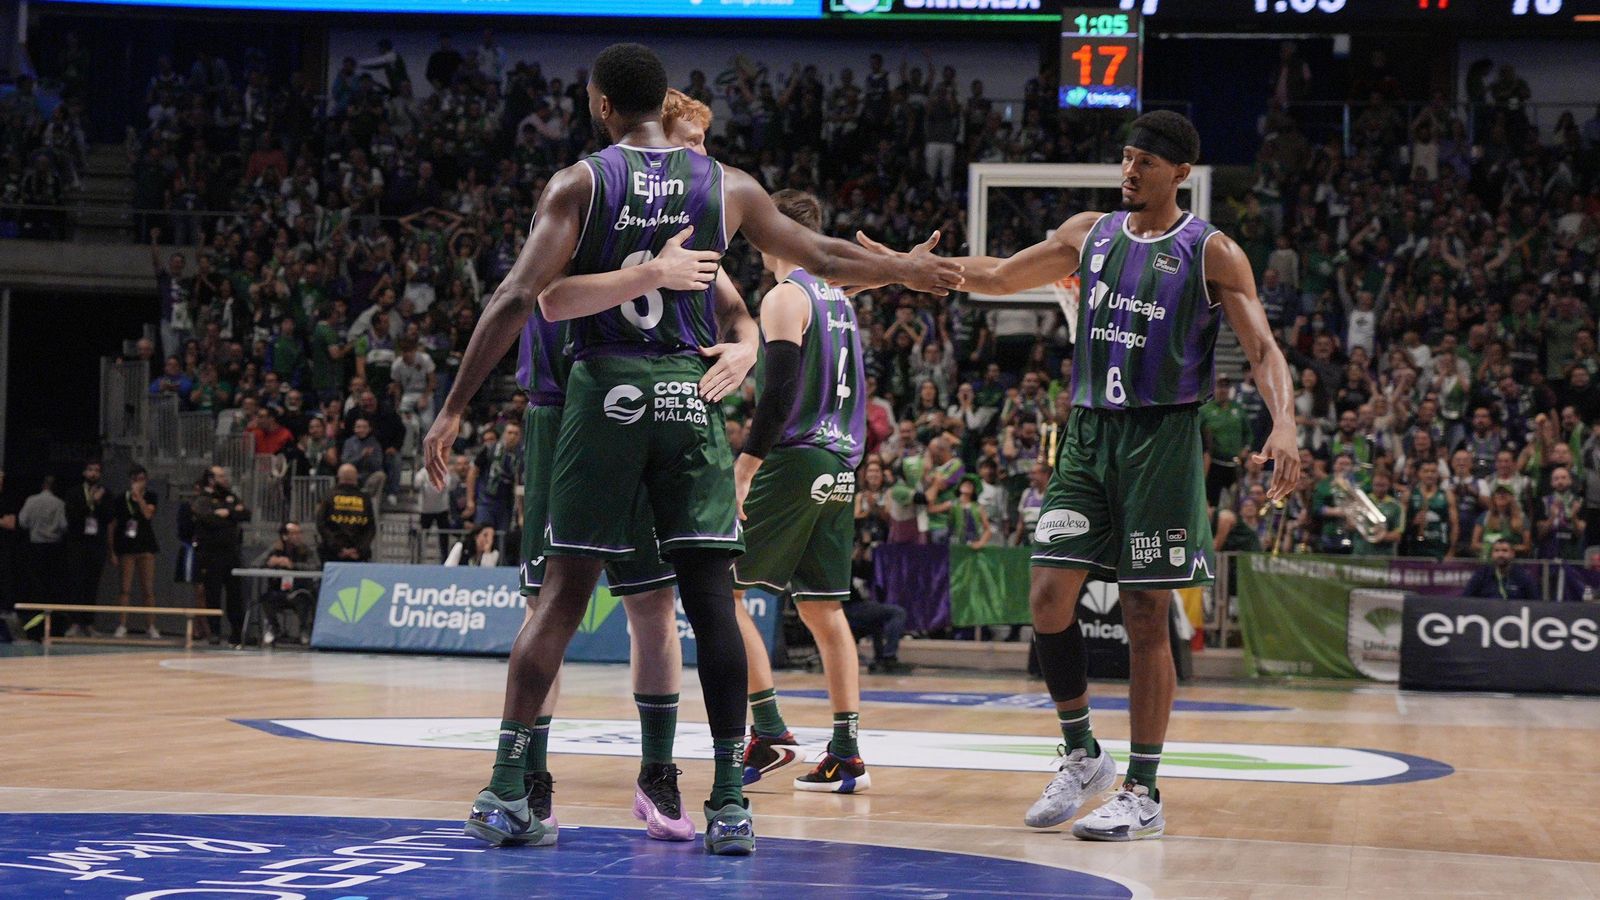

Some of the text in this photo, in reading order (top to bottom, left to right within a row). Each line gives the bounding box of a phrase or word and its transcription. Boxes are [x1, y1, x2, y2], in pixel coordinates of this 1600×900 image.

[1074, 13, 1129, 36] 1:05
[1072, 45, 1129, 86] 17
[633, 171, 685, 204] Ejim
[1108, 292, 1166, 322] Unicaja
[653, 381, 699, 397] COST
[836, 346, 852, 410] 4
[1105, 366, 1127, 404] 6
[654, 397, 684, 409] DEL
[654, 408, 708, 426] MÁLAGA
[836, 471, 856, 483] COS
[1040, 512, 1087, 530] amadesa
[391, 582, 527, 609] Fundación
[389, 605, 486, 635] Unicaja
[1417, 606, 1598, 652] endes
